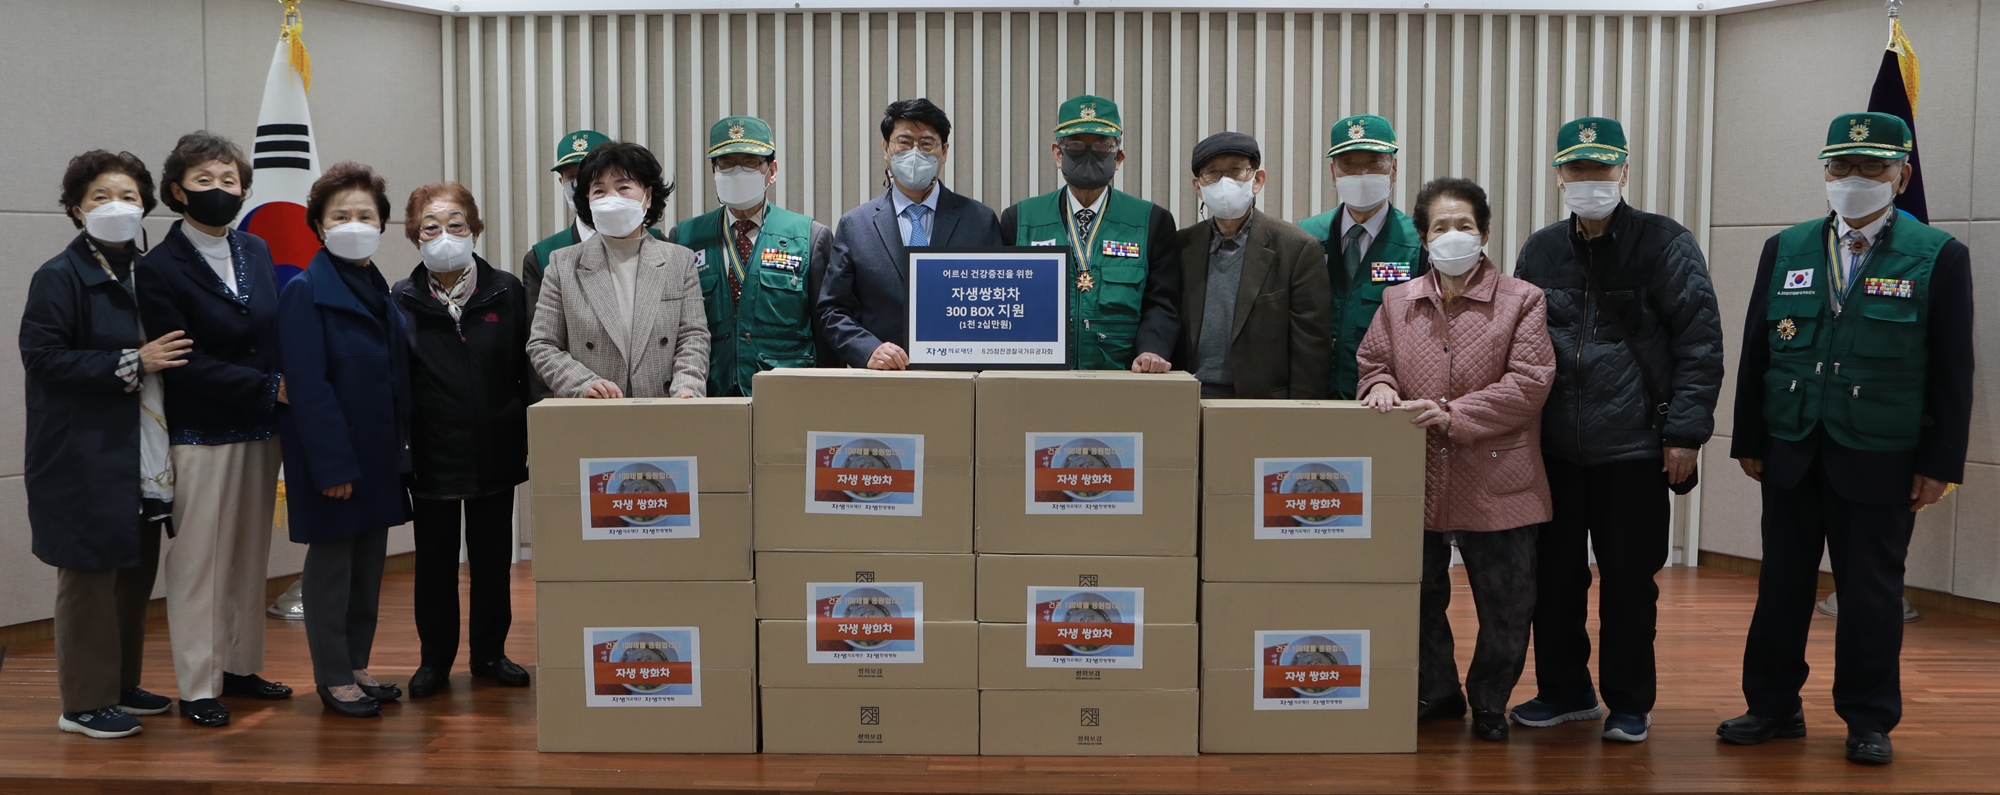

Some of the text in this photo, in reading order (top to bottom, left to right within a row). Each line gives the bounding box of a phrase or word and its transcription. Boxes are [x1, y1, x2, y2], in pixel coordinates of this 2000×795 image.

[942, 269, 1033, 279] 어르신 건강증진을 위한
[951, 287, 1020, 301] 자생쌍화차
[946, 303, 1024, 318] 300 BOX 지원
[959, 320, 1012, 330] (1천 2십만원)
[837, 474, 892, 486] 자생 쌍화차
[1057, 474, 1112, 485] 자생 쌍화차
[613, 499, 668, 510] 자생 쌍화차
[1286, 499, 1341, 510] 자생 쌍화차
[838, 623, 893, 635] 자생 쌍화차
[1058, 628, 1112, 639] 자생 쌍화차
[616, 668, 670, 679] 자생 쌍화차
[1285, 671, 1340, 682] 자생 쌍화차
